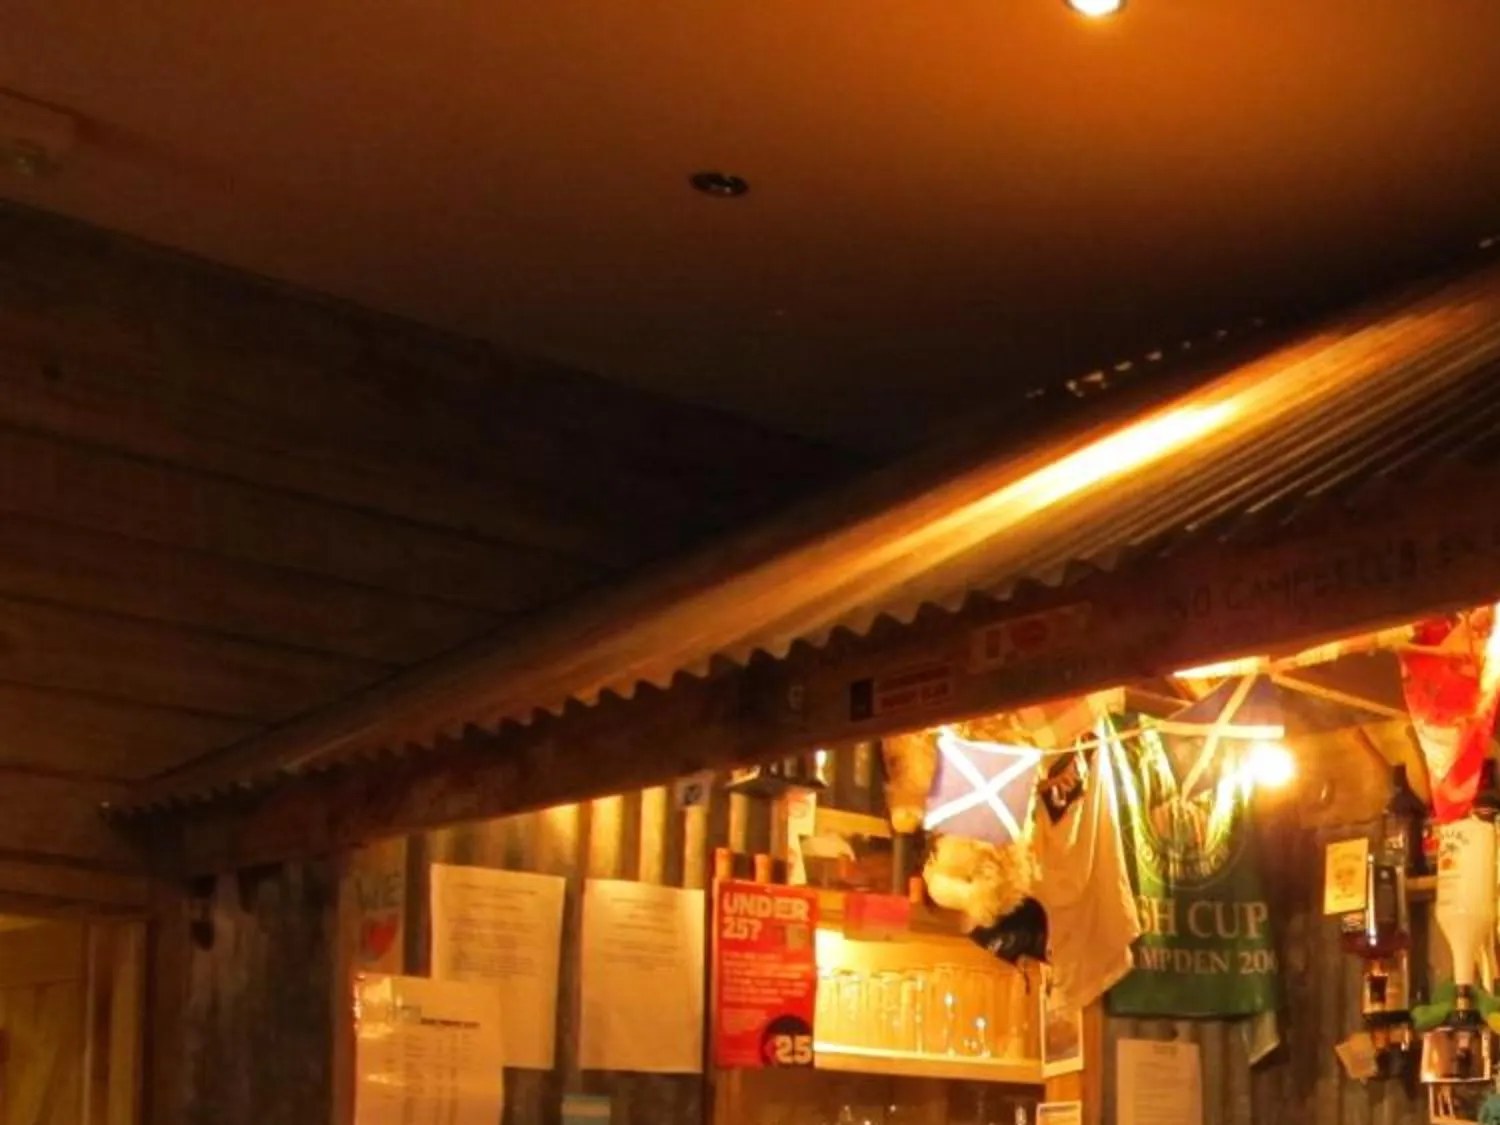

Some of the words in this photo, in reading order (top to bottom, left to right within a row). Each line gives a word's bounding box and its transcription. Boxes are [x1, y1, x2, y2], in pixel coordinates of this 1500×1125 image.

[721, 891, 811, 921] UNDER
[1186, 899, 1271, 941] CUP
[774, 1033, 813, 1066] 25
